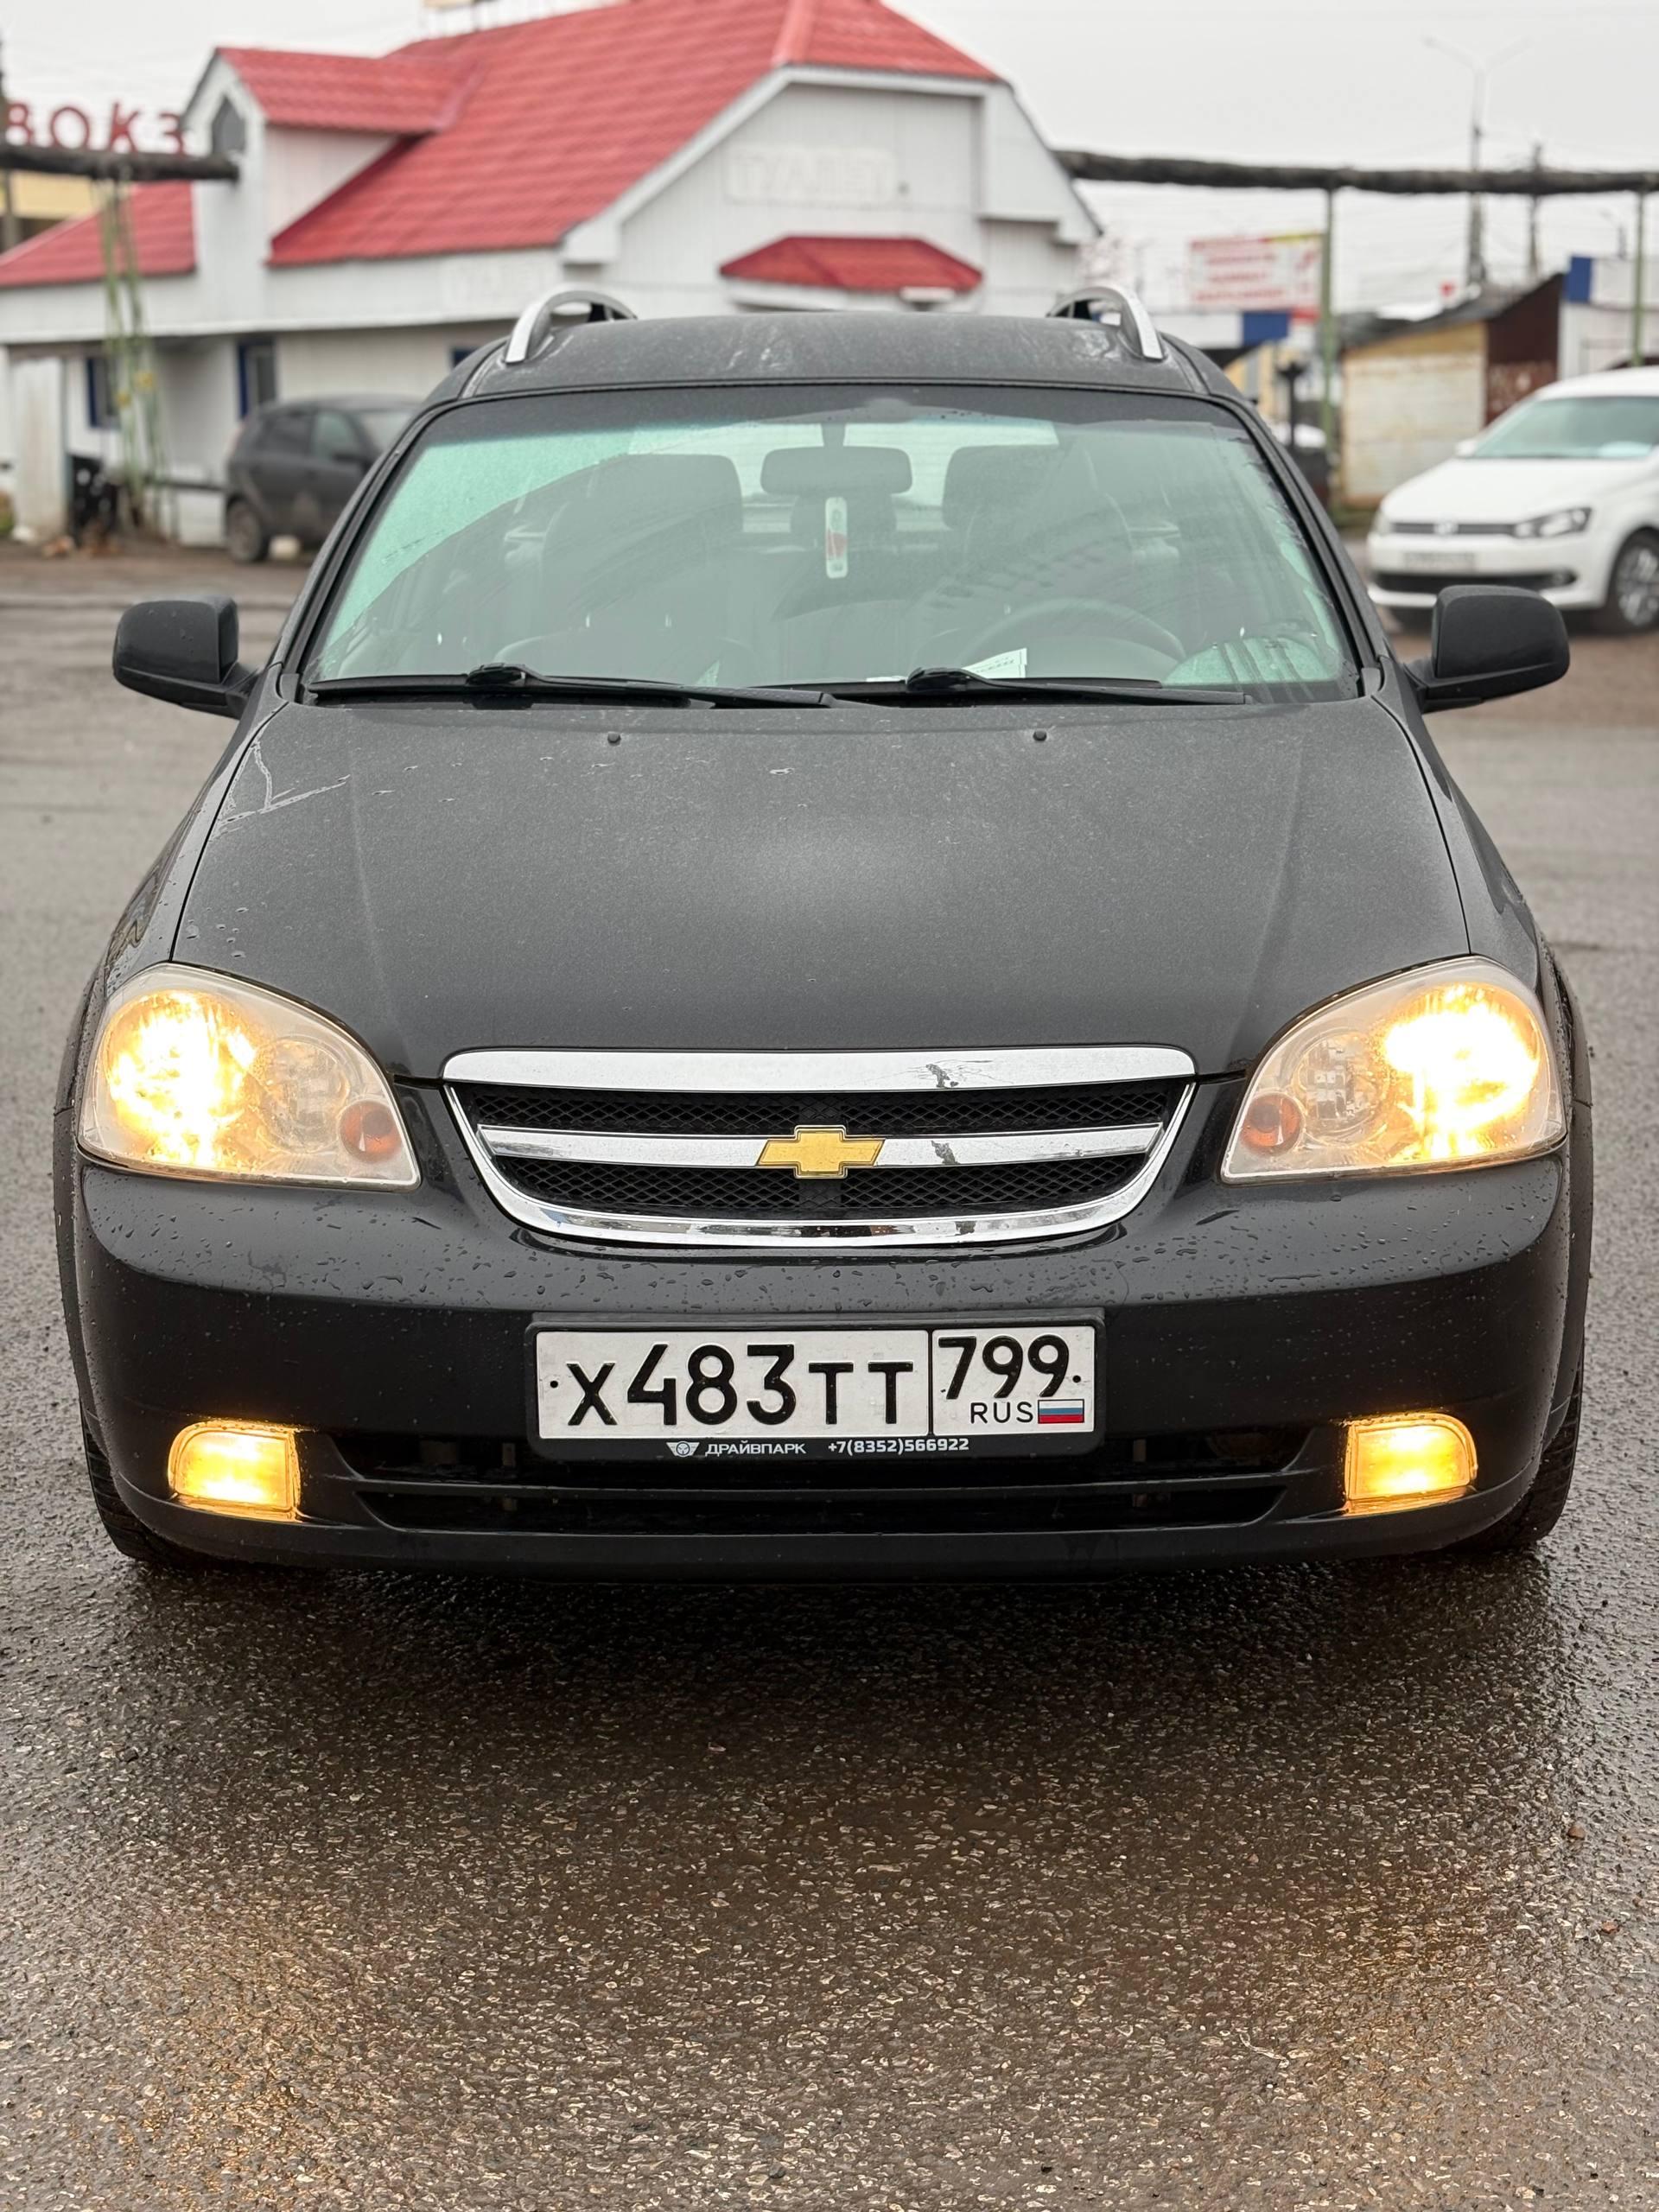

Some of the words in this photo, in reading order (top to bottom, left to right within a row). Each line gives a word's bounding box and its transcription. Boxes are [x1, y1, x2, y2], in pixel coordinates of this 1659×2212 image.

[938, 1335, 1070, 1400] 799
[970, 1402, 1033, 1425] RUS
[705, 1440, 806, 1457] ДРАЙВПАРК
[828, 1439, 969, 1455] +7(8352)566922
